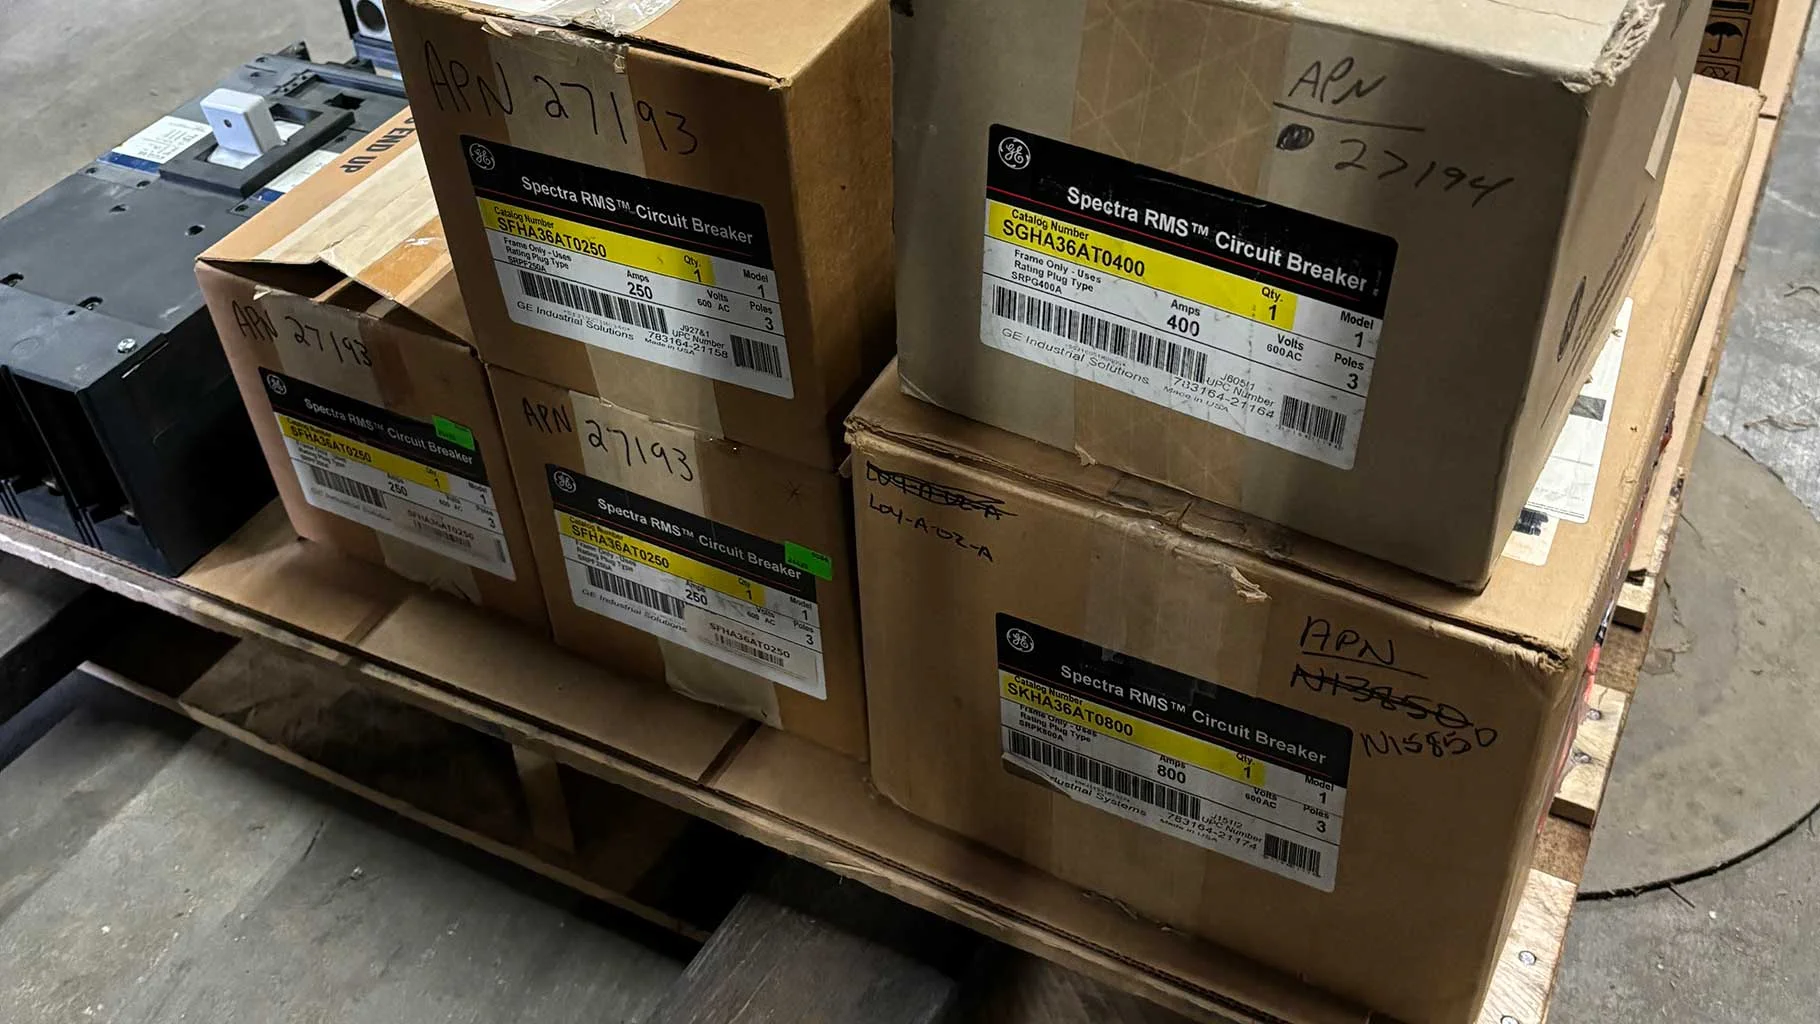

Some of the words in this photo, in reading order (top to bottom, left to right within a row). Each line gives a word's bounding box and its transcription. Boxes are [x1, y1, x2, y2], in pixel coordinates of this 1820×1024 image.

[1288, 56, 1387, 105] APN
[424, 40, 514, 117] APN
[533, 75, 698, 155] 27193
[340, 156, 378, 174] UP
[494, 206, 524, 223] Catalog
[525, 214, 554, 229] Number
[521, 176, 577, 203] Spectra
[636, 205, 689, 229] Circuit
[692, 218, 753, 245] Breaker
[1012, 209, 1048, 230] Catalog
[1051, 221, 1089, 241] Number
[497, 217, 607, 258] SFHA36AT0250
[1067, 187, 1138, 222] Spectra
[1144, 209, 1209, 237] RMS™
[1215, 231, 1282, 267] Circuit
[1287, 253, 1367, 292] Breaker
[503, 237, 527, 251] Frame
[529, 244, 546, 256] Only
[553, 252, 572, 262] Uses
[506, 245, 531, 261] Rating
[532, 253, 550, 265] Plug
[550, 259, 569, 270] Type
[1003, 220, 1145, 277] SGHA36AT0400
[694, 269, 702, 282] 1
[743, 269, 769, 282] Model
[1014, 250, 1044, 266] Frame
[1046, 260, 1069, 274] Only
[1077, 269, 1101, 283] Uses
[626, 270, 650, 283] Amps
[1011, 272, 1062, 294] SRPG400A
[1014, 260, 1044, 278] Rating
[1046, 271, 1068, 286] Plug
[1071, 278, 1094, 293] Type
[627, 282, 653, 299] 250
[706, 289, 729, 302] Volts
[758, 285, 765, 298] 1
[718, 304, 730, 313] AC
[750, 300, 773, 315] Poles
[1170, 298, 1201, 318] Amps
[1269, 304, 1277, 320] 1
[517, 301, 533, 312] GE
[536, 306, 583, 326] Industrial
[586, 320, 634, 341] Solutions
[764, 317, 774, 331] 3
[1166, 314, 1200, 337] 400
[1340, 310, 1374, 330] Model
[232, 300, 278, 343] APN
[284, 315, 372, 367] 27193
[672, 330, 691, 341] UPC
[692, 335, 725, 349] Number
[1277, 334, 1304, 350] Volts
[1355, 331, 1363, 348] 1
[648, 332, 729, 359] 783164-21158
[1002, 327, 1022, 341] GE
[1026, 335, 1085, 362] Industrial
[1089, 357, 1150, 385] Solutions
[1334, 352, 1364, 370] Poles
[1347, 373, 1359, 390] 3
[1173, 377, 1275, 418] 783164-21164
[1206, 376, 1231, 392] UPC
[1233, 386, 1274, 408] Number
[304, 398, 346, 421] Spectra
[387, 427, 426, 450] Circuit
[428, 442, 473, 465] Breaker
[522, 397, 572, 434] APN
[585, 419, 694, 482] 27193
[388, 481, 408, 497] 250
[480, 494, 487, 504] 1
[488, 517, 496, 528] 3
[572, 525, 670, 569] SFHA36AT0250
[598, 498, 647, 525] Spectra
[699, 535, 744, 561] Circuit
[748, 553, 802, 580] Breaker
[685, 589, 708, 605] 250
[747, 590, 753, 600] 1
[802, 609, 809, 621] 1
[806, 633, 814, 646] 3
[1300, 616, 1394, 665] APN
[1014, 676, 1048, 695] Catalog
[1049, 688, 1084, 706] Number
[1007, 682, 1133, 737] SKHA36AT0800
[1061, 665, 1124, 698] Spectra
[1129, 688, 1186, 713] RMS™
[1192, 709, 1250, 741] Circuit
[1256, 730, 1327, 765] Breaker
[1020, 712, 1048, 729] Rating
[1050, 722, 1068, 736] Plug
[1071, 729, 1091, 743] Type
[1159, 754, 1186, 770] Amps
[1157, 765, 1186, 784] 800
[1244, 767, 1251, 779] 1
[1305, 775, 1334, 792] Model
[1253, 787, 1278, 801] Volts
[1319, 792, 1327, 804] 1
[1096, 792, 1147, 817] Systems
[1303, 803, 1329, 820] Poles
[1226, 825, 1263, 843] Number
[1316, 820, 1326, 834] 3
